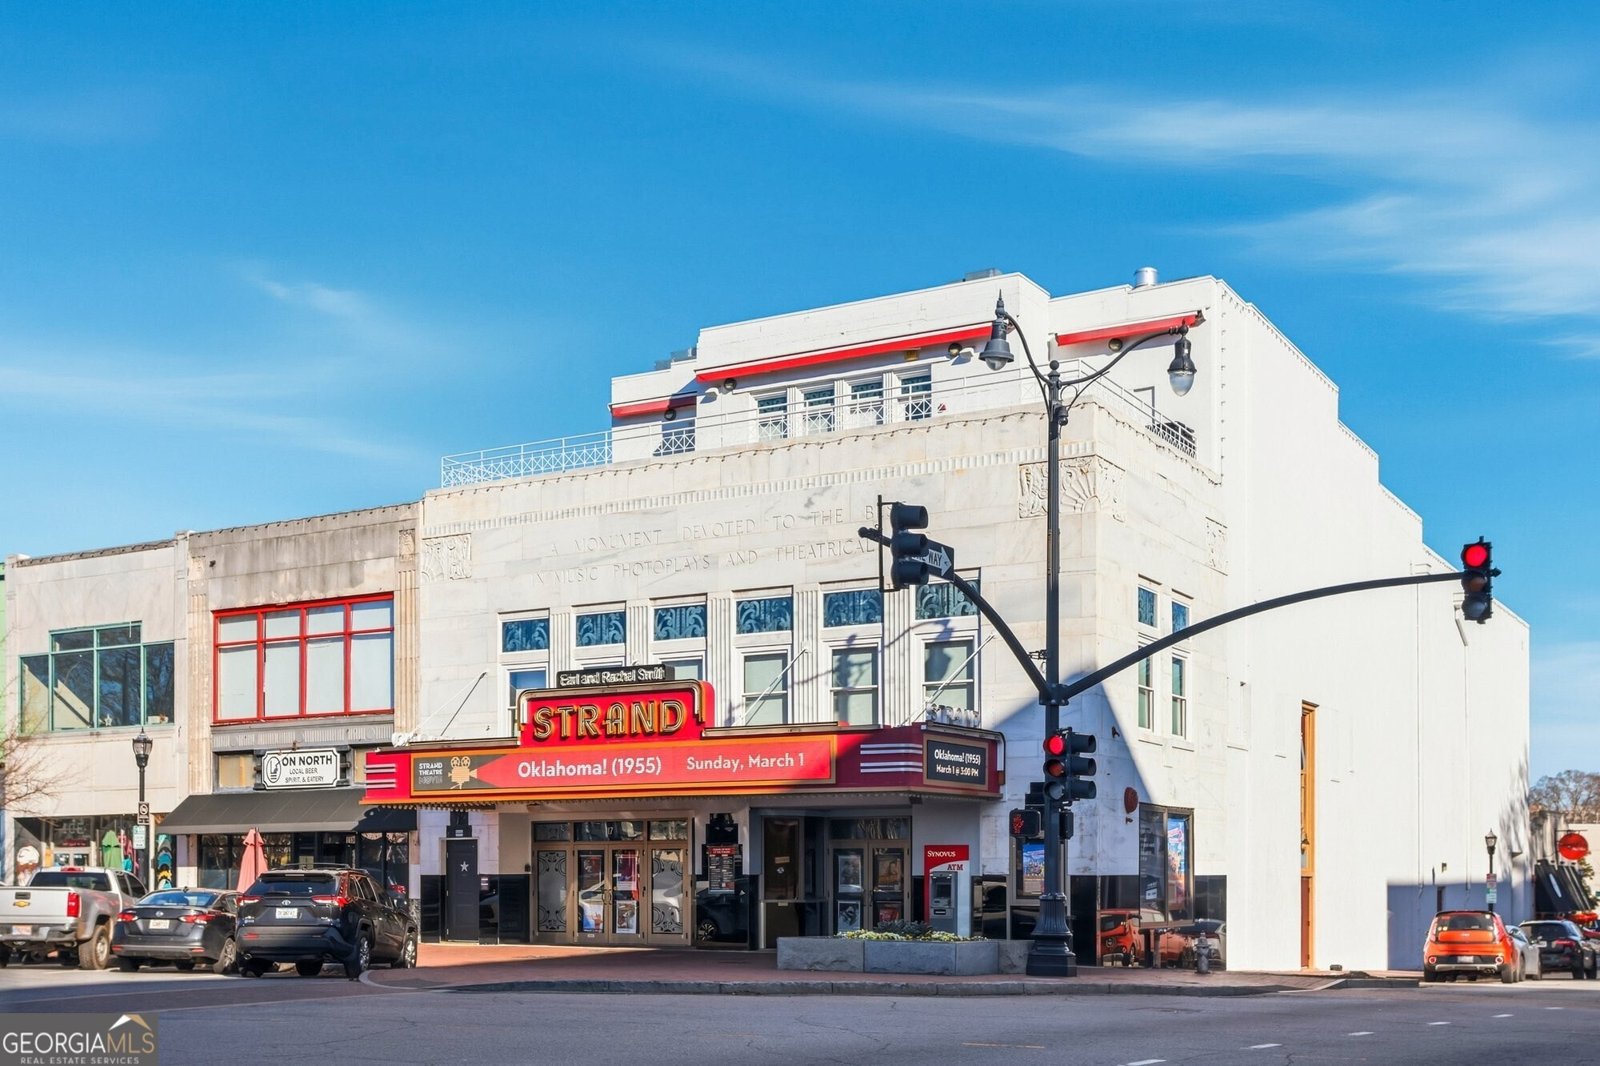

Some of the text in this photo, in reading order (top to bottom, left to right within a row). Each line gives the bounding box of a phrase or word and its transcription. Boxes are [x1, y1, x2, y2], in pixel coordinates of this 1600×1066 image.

[574, 530, 662, 551] MONUMENT
[682, 519, 756, 541] DEVOTED
[772, 514, 795, 531] TO
[811, 508, 843, 526] THE
[554, 567, 598, 584] MUSIC
[613, 554, 710, 577] PHOTOPLAYS
[726, 550, 758, 567] AND
[775, 538, 874, 562] THEATRICAL
[928, 550, 942, 567] WAY
[559, 666, 666, 686] Earl and Rachel Smith
[533, 699, 687, 739] STRAND
[282, 755, 332, 766] ON NORTH
[517, 752, 804, 778] Oklahoma! (1955) Sunday, March 1
[934, 748, 981, 766] Oklahoma! (1955)
[418, 762, 443, 770] STRAND
[936, 764, 952, 774] March
[960, 767, 970, 776] 3:00
[971, 768, 979, 777] PM
[927, 850, 957, 858] SYNOVUS
[947, 863, 964, 871] ATM
